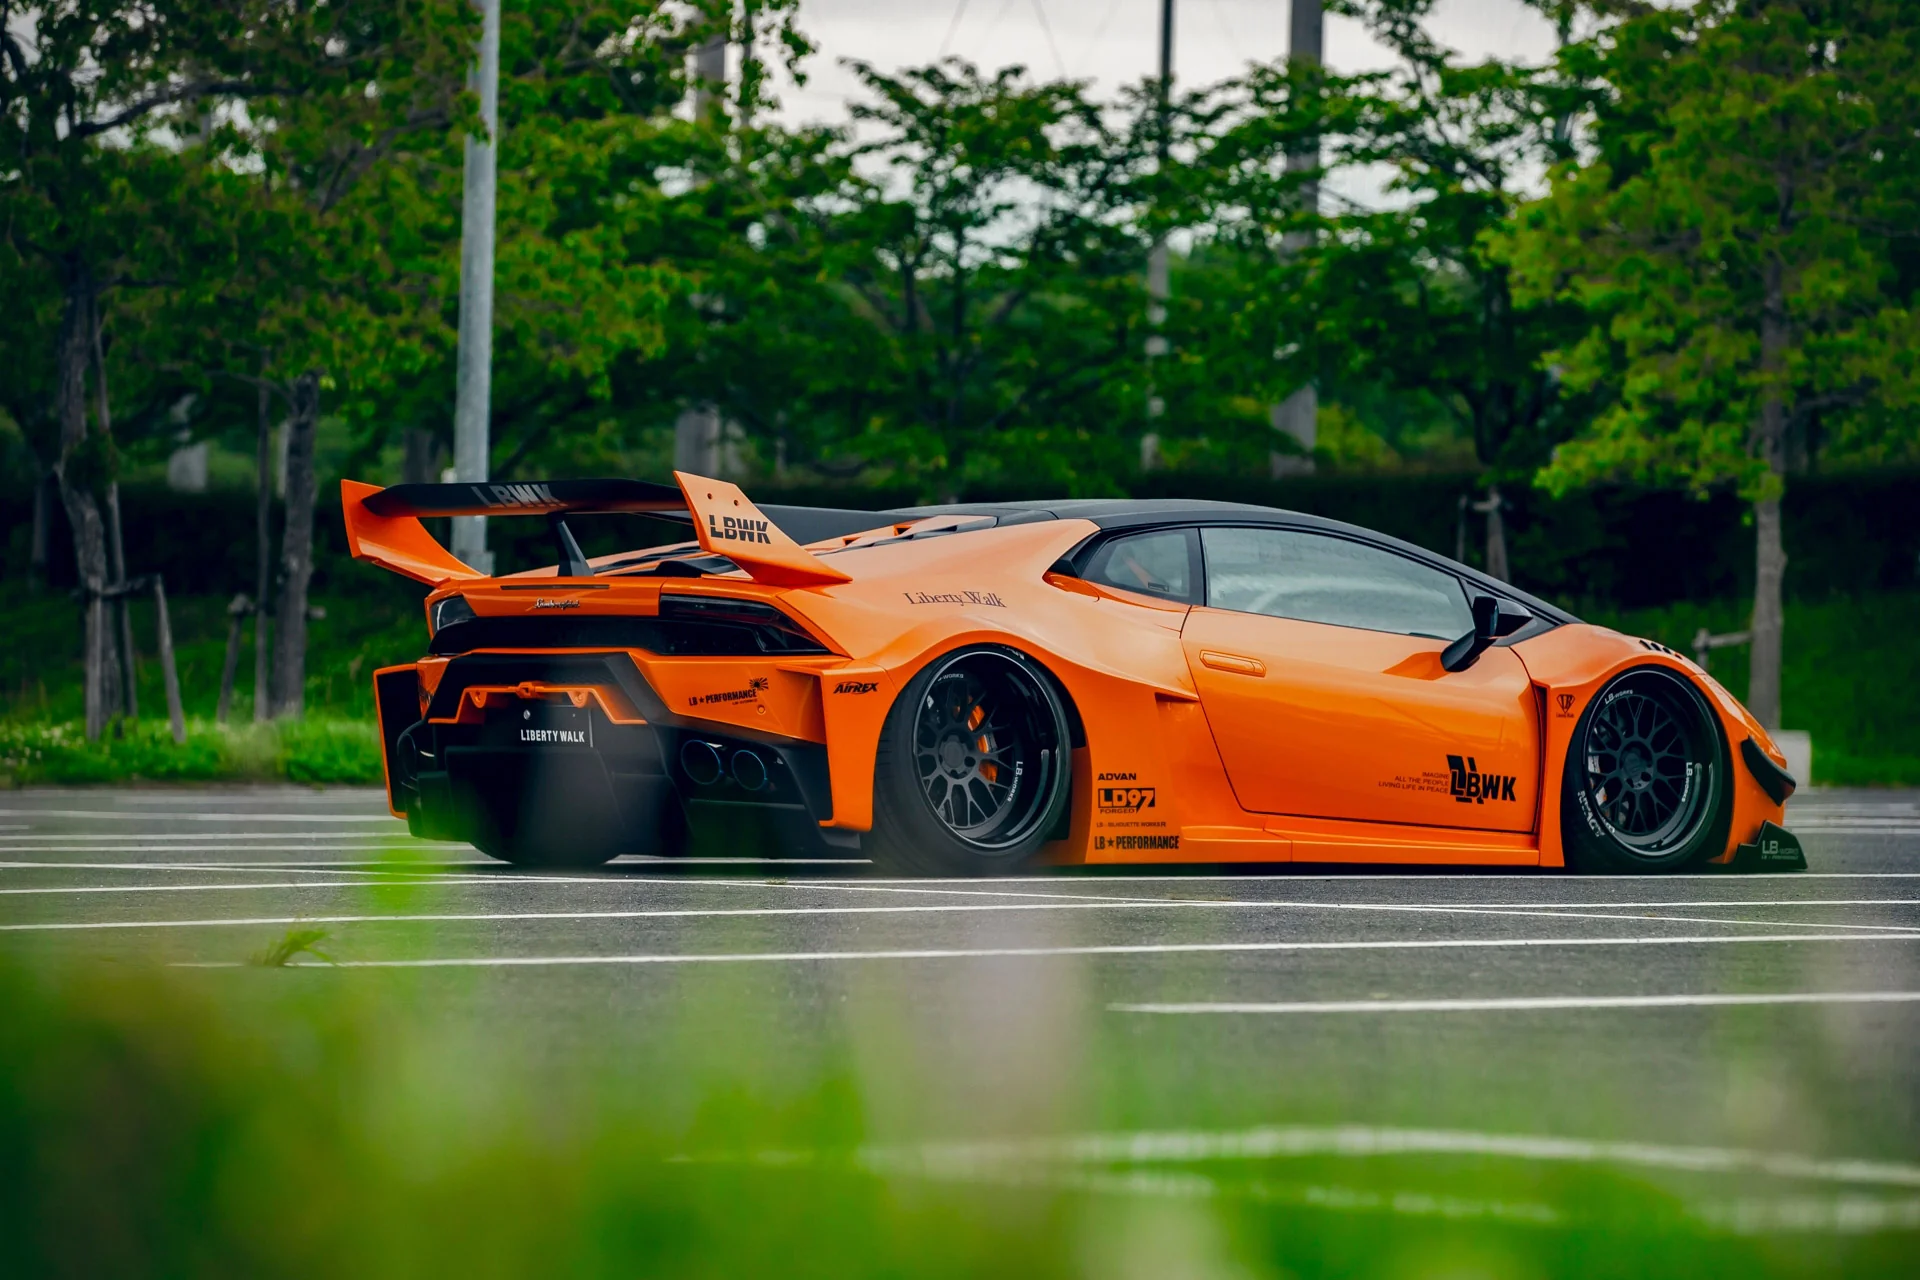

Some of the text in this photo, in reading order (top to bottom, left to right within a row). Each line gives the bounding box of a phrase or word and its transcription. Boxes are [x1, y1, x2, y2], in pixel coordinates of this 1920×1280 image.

[709, 514, 772, 545] LBWK
[903, 590, 1007, 608] Liberty Walk
[688, 696, 698, 706] LB
[705, 689, 757, 704] PERFORMANCE
[520, 729, 585, 743] LIBERTY WALK
[1097, 772, 1137, 781] ADVAN
[1395, 775, 1449, 787] ALL THE PEOPLE
[1422, 771, 1449, 780] IMAGINE
[1378, 781, 1401, 789] LIVING
[1402, 783, 1416, 791] LIFE
[1427, 786, 1449, 794] PEACE
[1450, 769, 1516, 802] LBWK
[1098, 788, 1156, 811] LD97
[1094, 835, 1180, 850] LB PERFORMANCE
